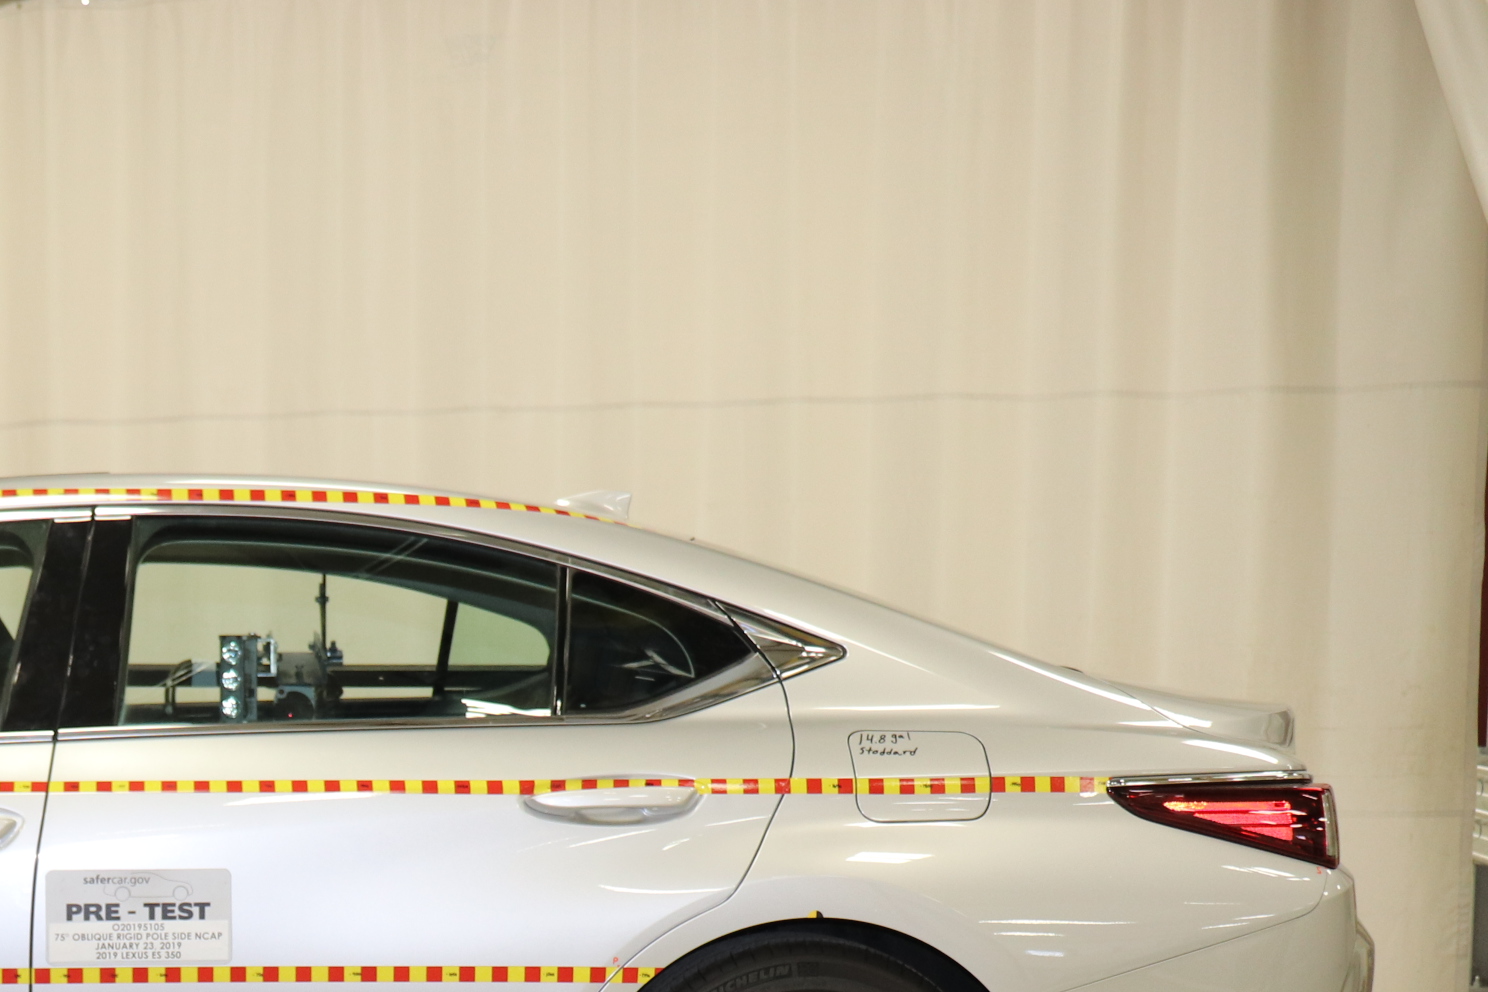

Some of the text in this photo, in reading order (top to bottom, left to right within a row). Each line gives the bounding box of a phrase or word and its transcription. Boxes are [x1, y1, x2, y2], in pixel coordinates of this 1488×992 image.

[83, 874, 151, 886] safercar.gov
[66, 903, 120, 921] PRE
[143, 902, 211, 920] TEST
[72, 932, 113, 942] OBLIQUE
[117, 932, 142, 941] RIGID
[146, 932, 169, 941] POLE
[172, 932, 192, 941] SIDE
[195, 932, 223, 941] NCAP
[95, 942, 140, 951] JANUARY
[160, 942, 182, 950] 2019
[96, 951, 182, 960] 2019 LEXUS ES 350
